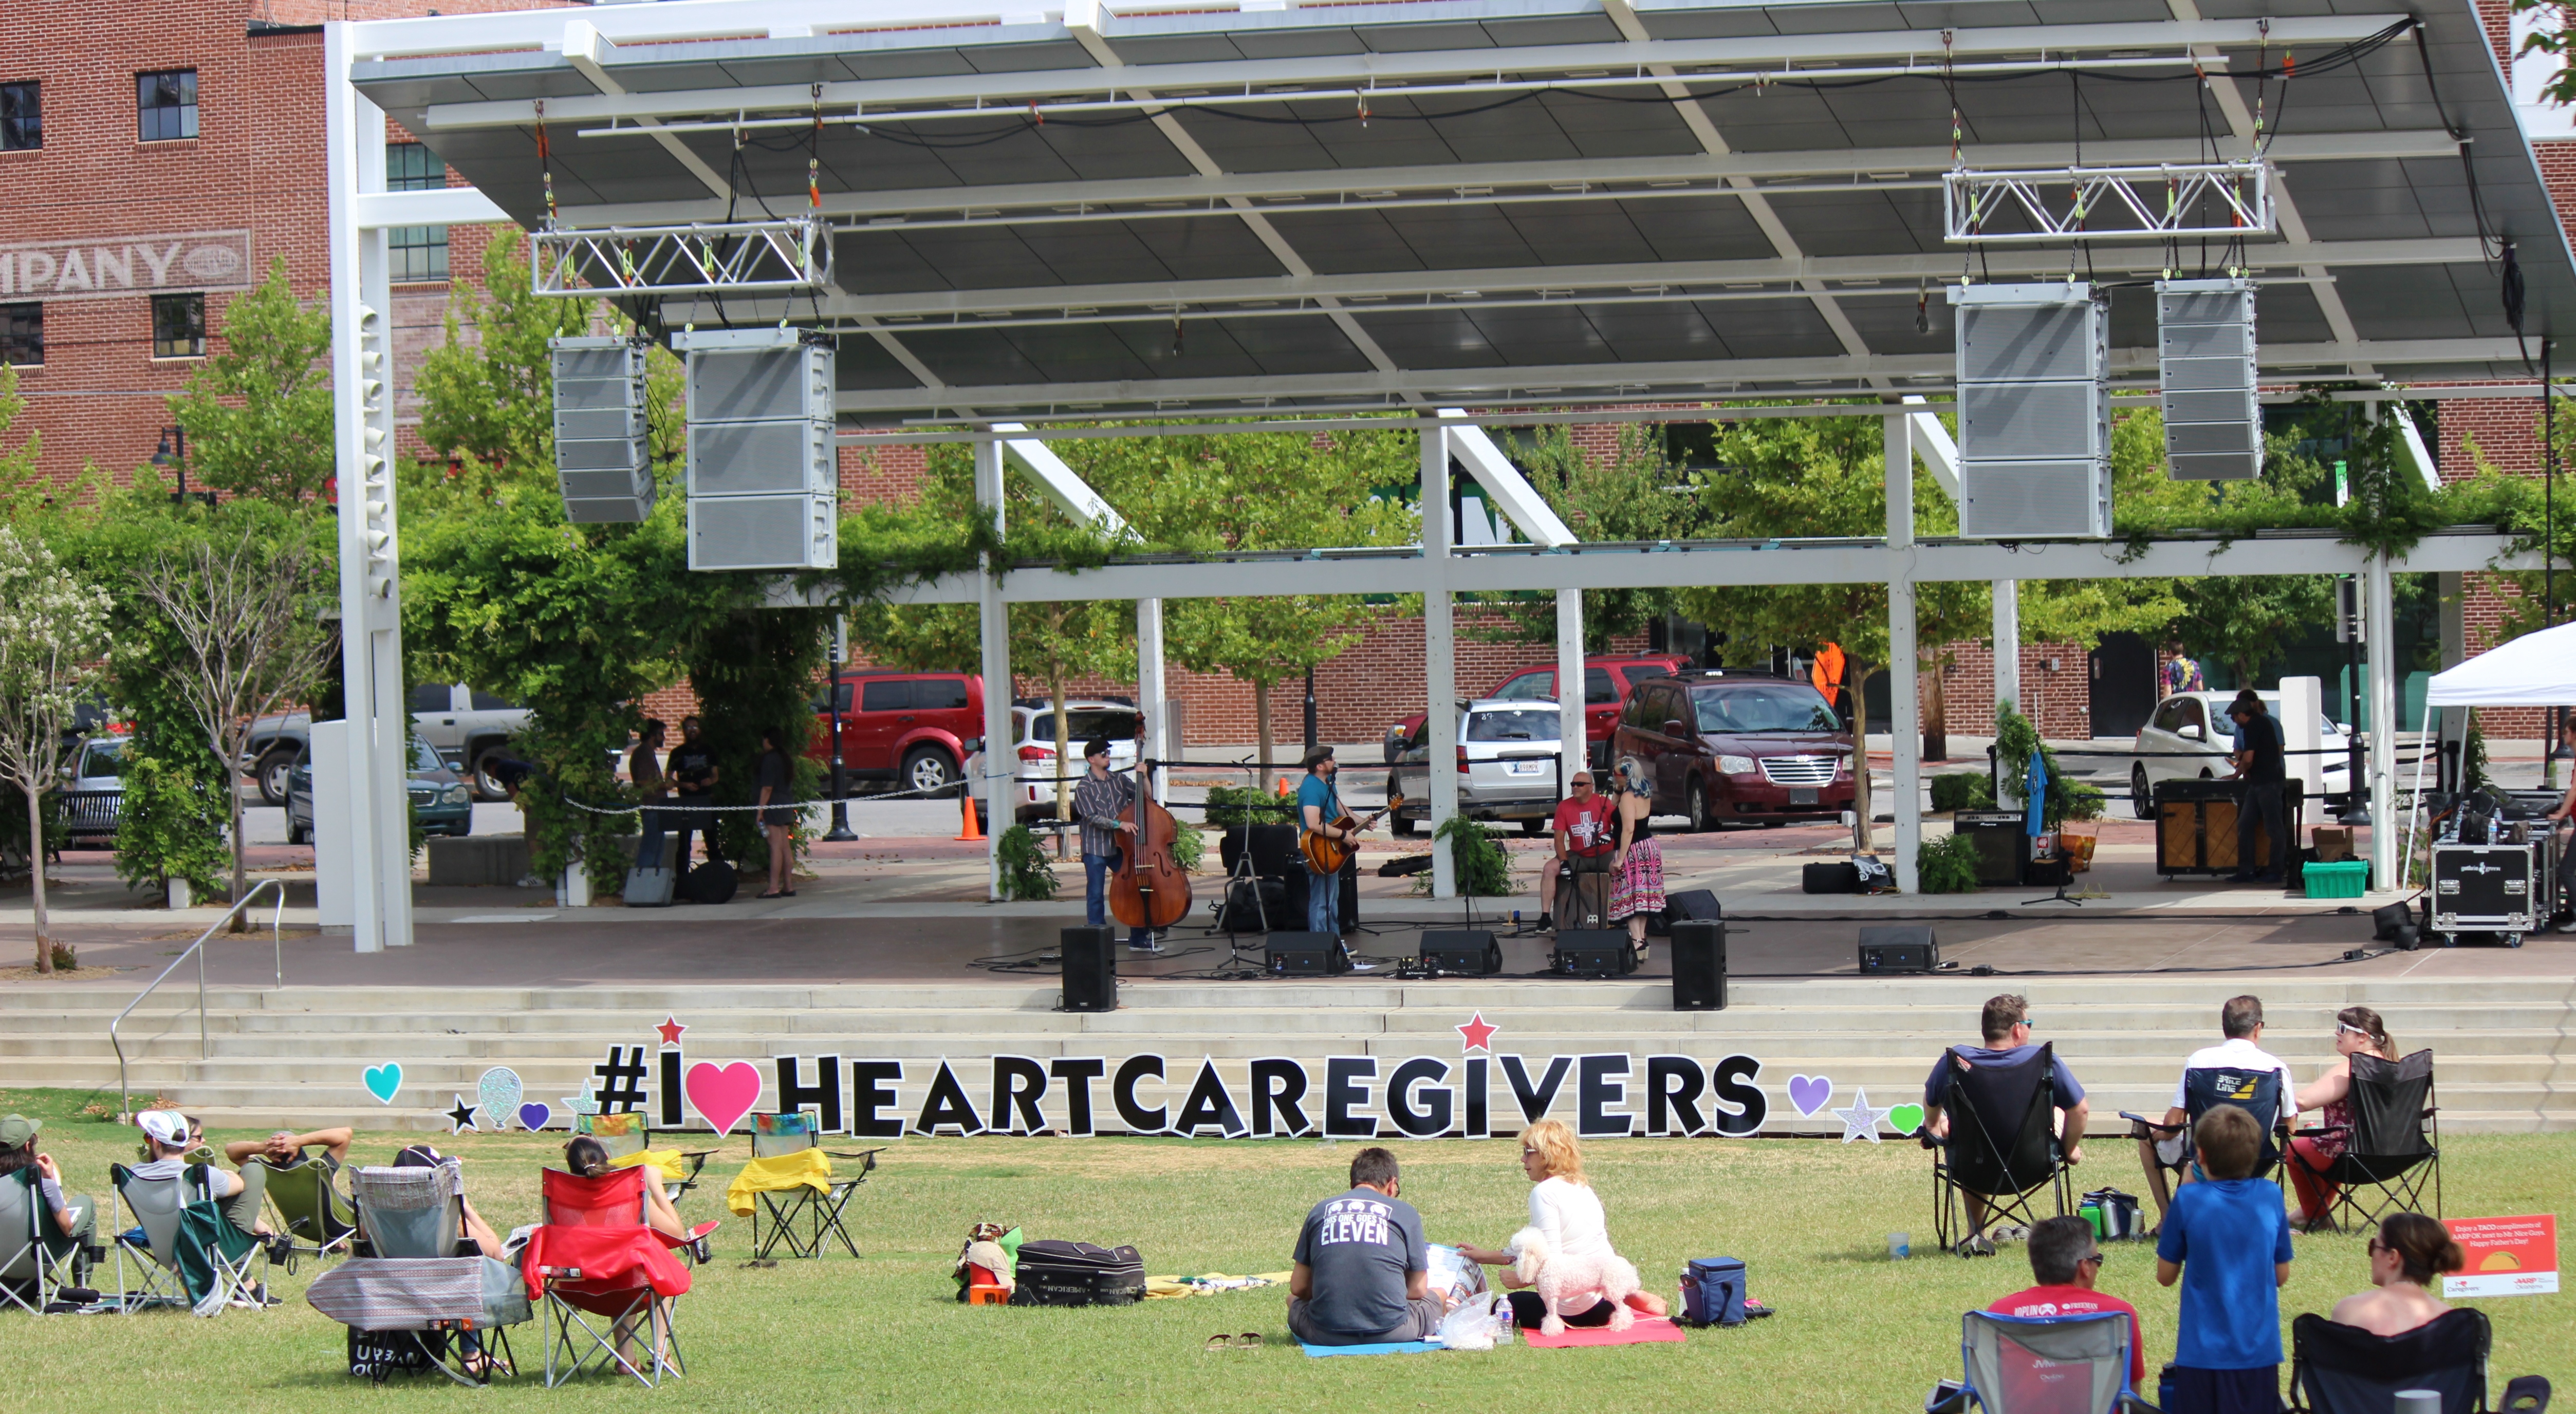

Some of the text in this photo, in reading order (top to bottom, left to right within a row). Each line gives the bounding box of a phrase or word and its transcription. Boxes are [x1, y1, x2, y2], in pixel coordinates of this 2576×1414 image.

[1324, 1214, 1387, 1226] THIS ONE GOES TO
[2496, 1222, 2534, 1231] compliments
[1321, 1221, 1387, 1246] ELEVEN
[1048, 1285, 1086, 1293] AMERICAN
